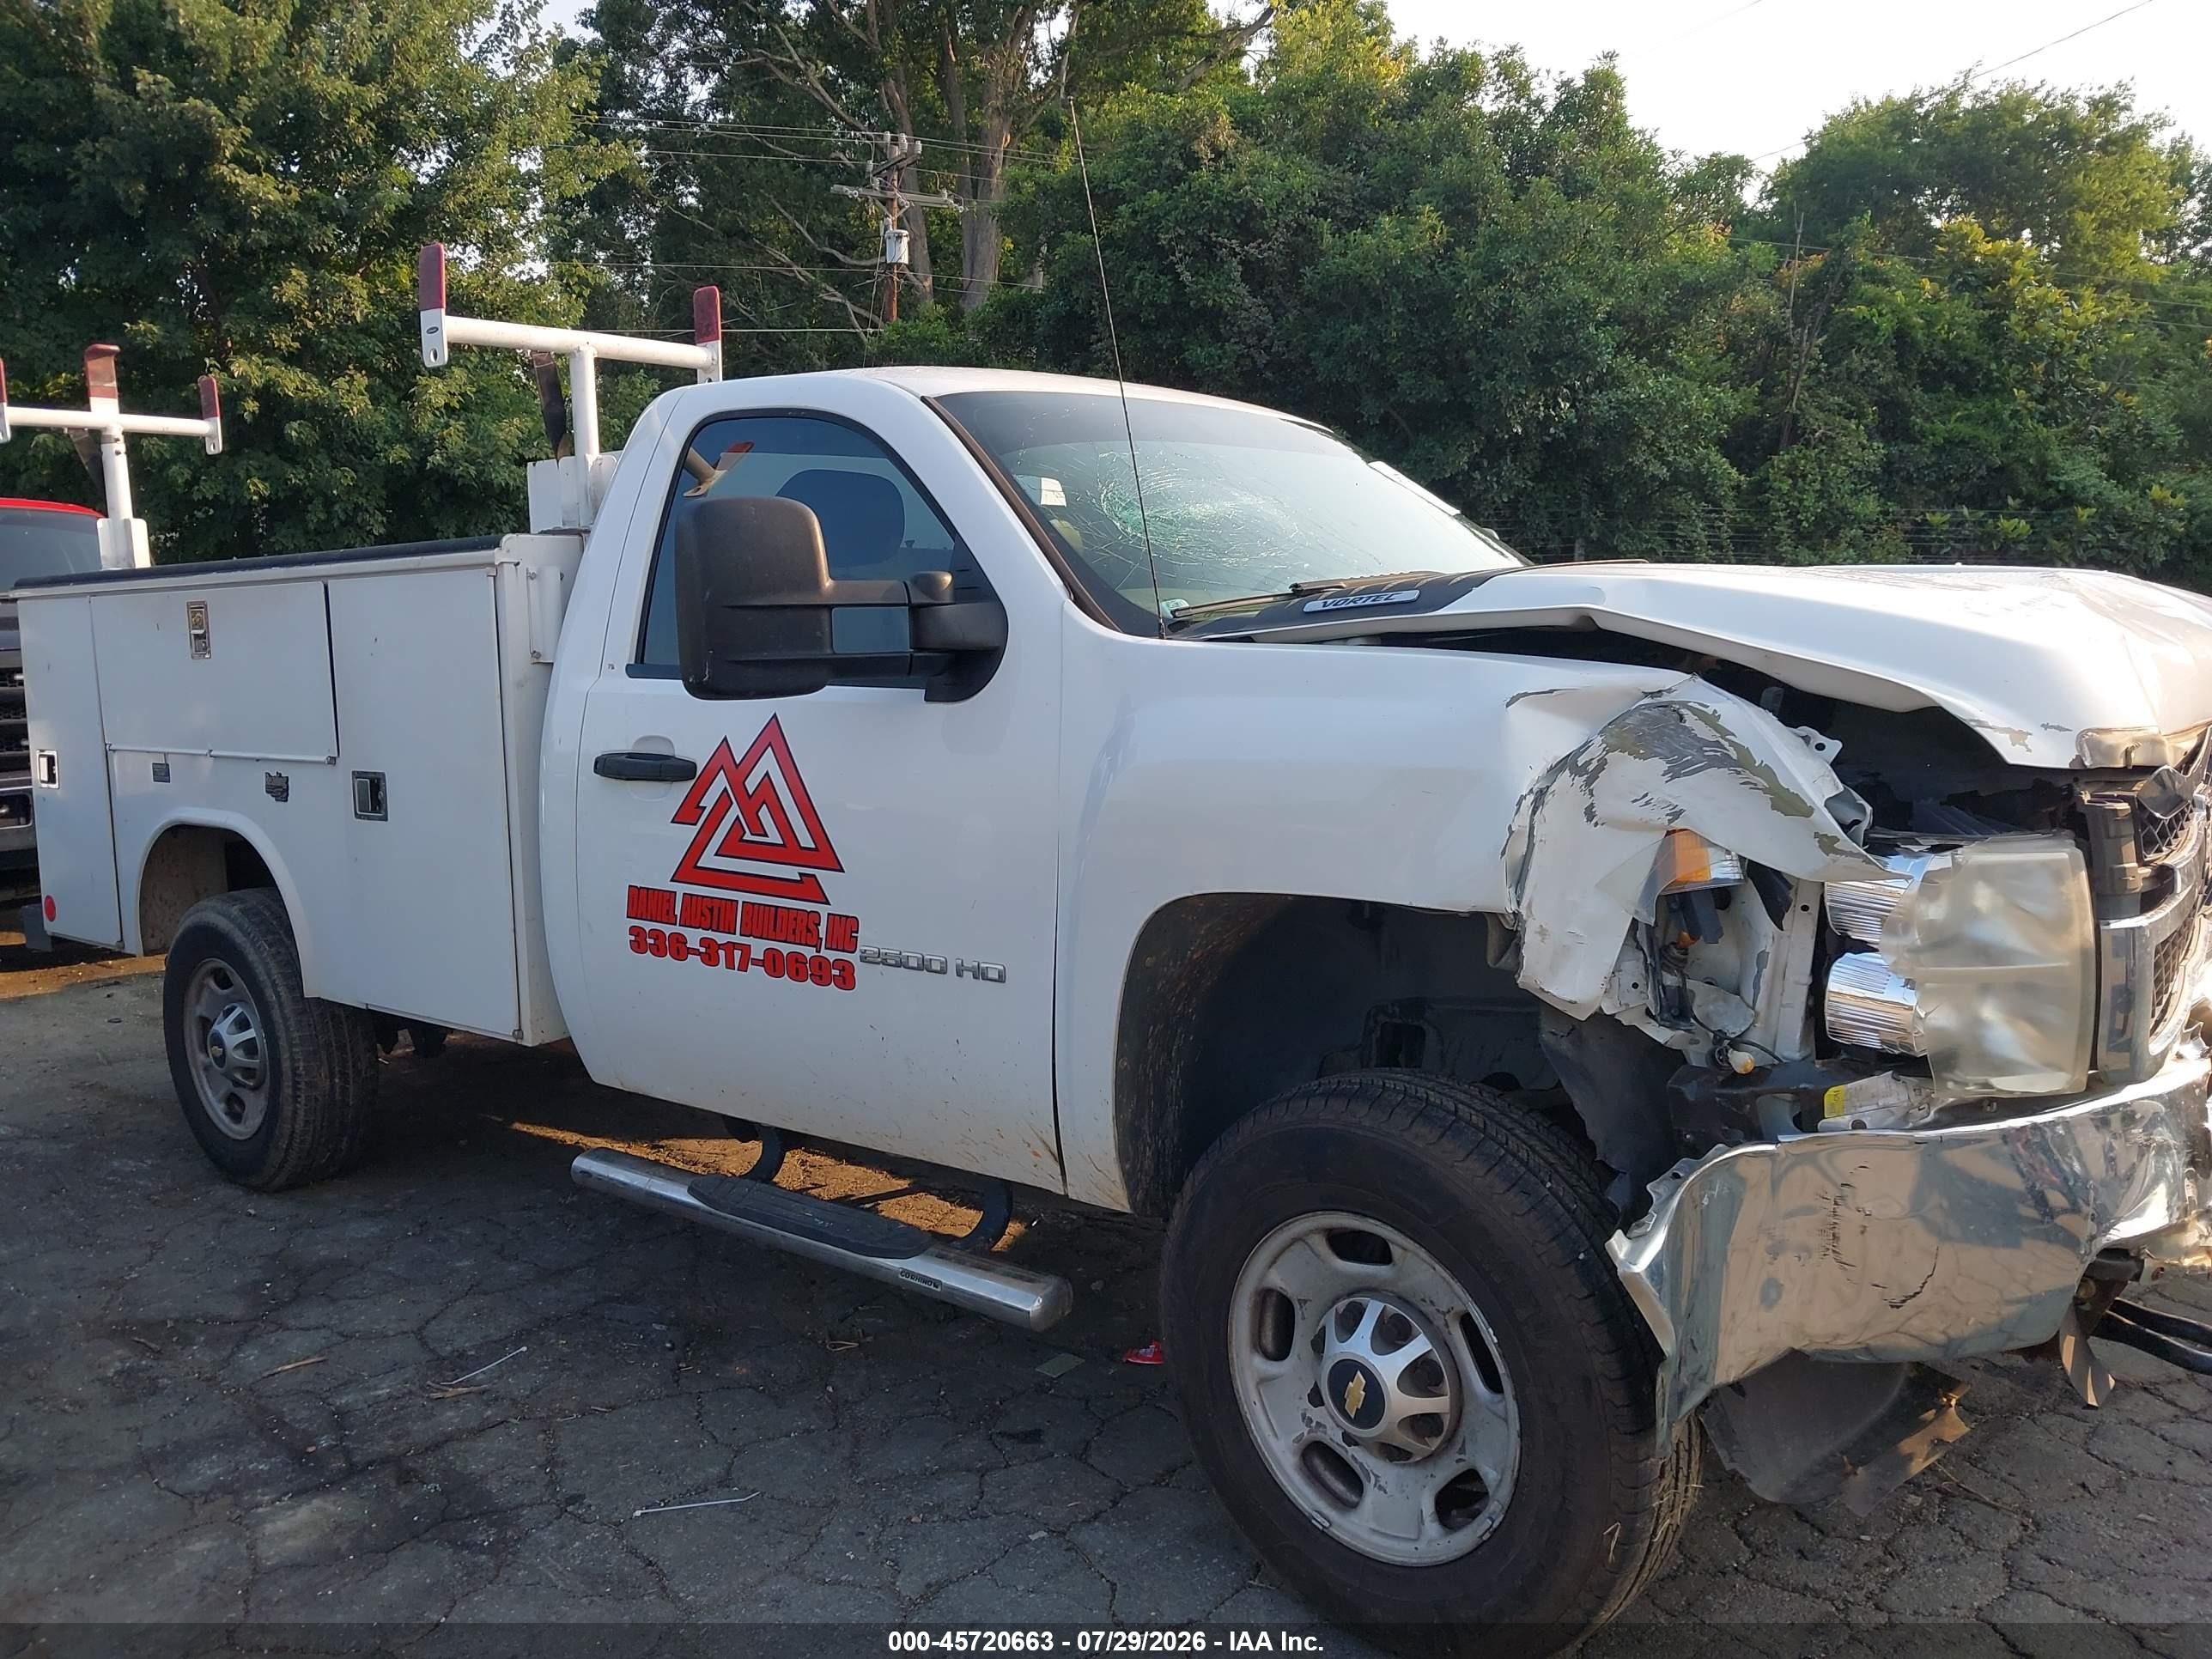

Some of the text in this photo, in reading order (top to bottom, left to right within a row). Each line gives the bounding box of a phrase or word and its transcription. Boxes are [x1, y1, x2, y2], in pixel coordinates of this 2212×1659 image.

[1322, 592, 1403, 608] VORTEC
[626, 884, 859, 954] DANIEL AUSTIN BUILDERS, INC
[628, 925, 857, 991] 336-317-0693
[860, 945, 1006, 984] 2500 HD
